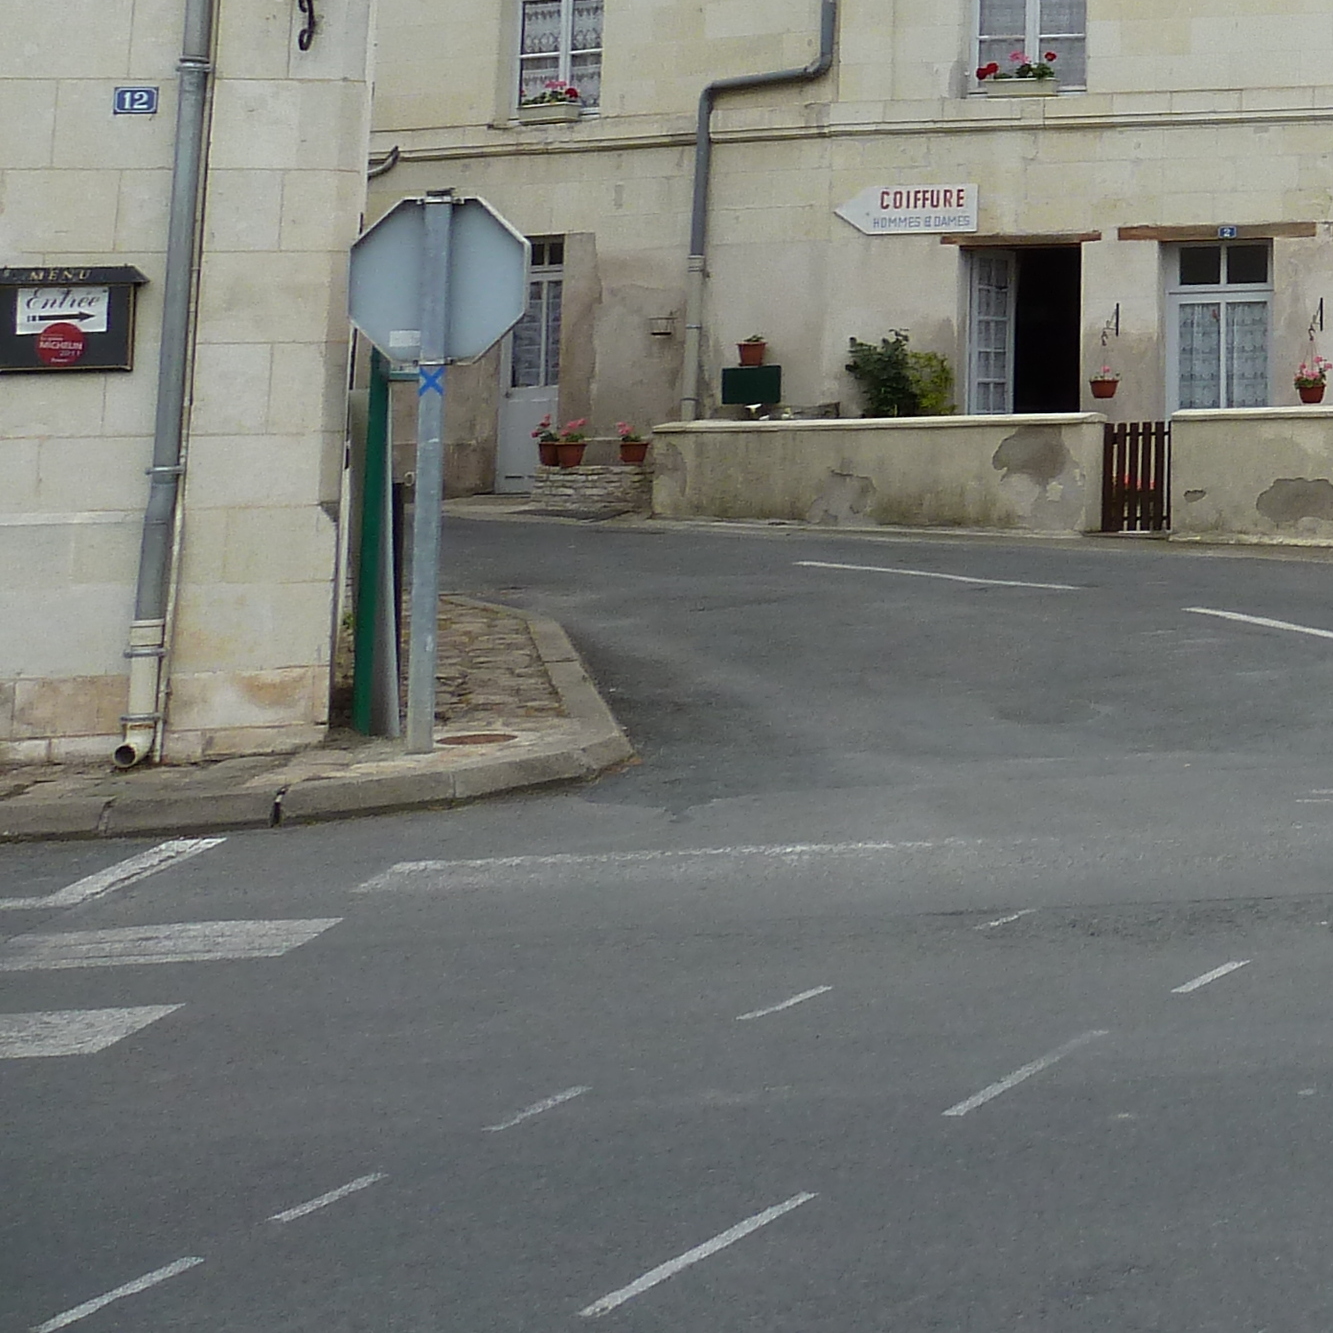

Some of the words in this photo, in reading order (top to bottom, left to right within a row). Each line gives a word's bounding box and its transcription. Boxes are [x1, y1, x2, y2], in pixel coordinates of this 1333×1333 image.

[124, 91, 148, 109] 12
[880, 188, 965, 210] COIFFURE
[873, 217, 921, 228] HOMMES
[934, 215, 970, 227] DAMES
[1223, 228, 1232, 237] 2
[30, 268, 91, 281] MENU
[26, 287, 103, 309] Entrée
